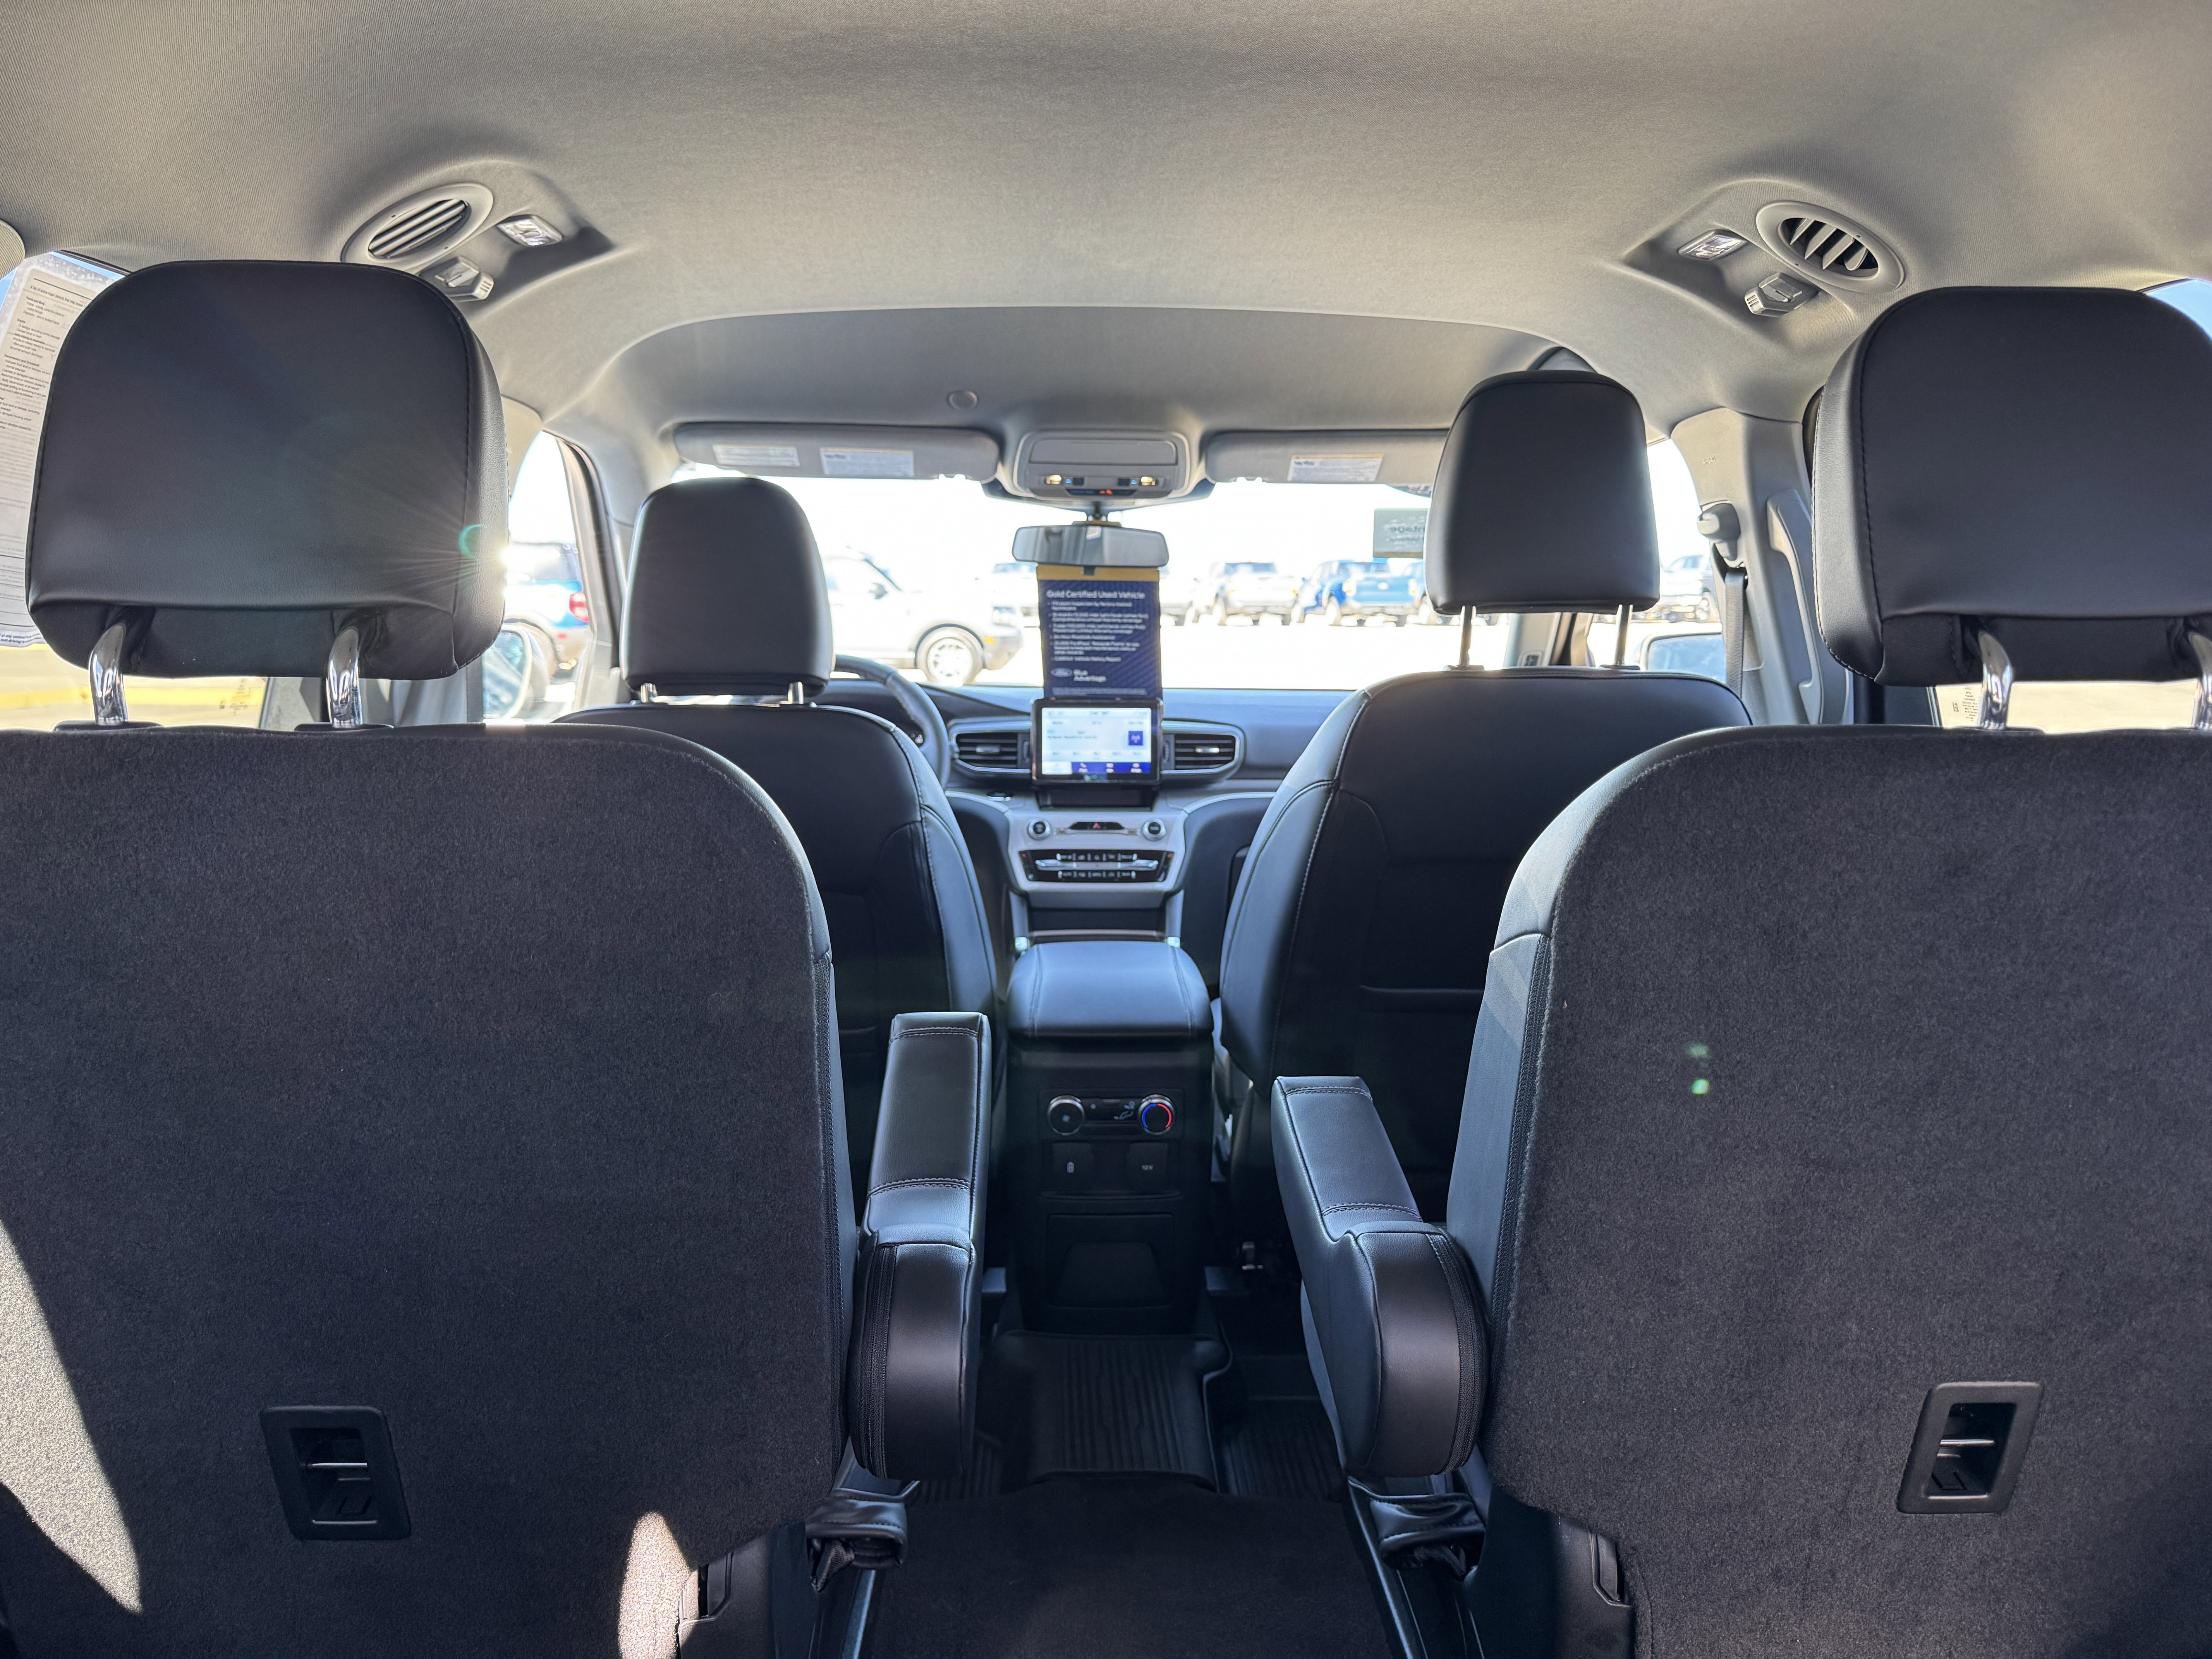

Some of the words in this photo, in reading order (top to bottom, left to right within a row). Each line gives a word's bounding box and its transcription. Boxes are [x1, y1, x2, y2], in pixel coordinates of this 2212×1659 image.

[1046, 589, 1065, 598] Gold
[1065, 589, 1097, 598] Certified
[1098, 590, 1118, 599] Used
[1118, 590, 1146, 599] Vehicle
